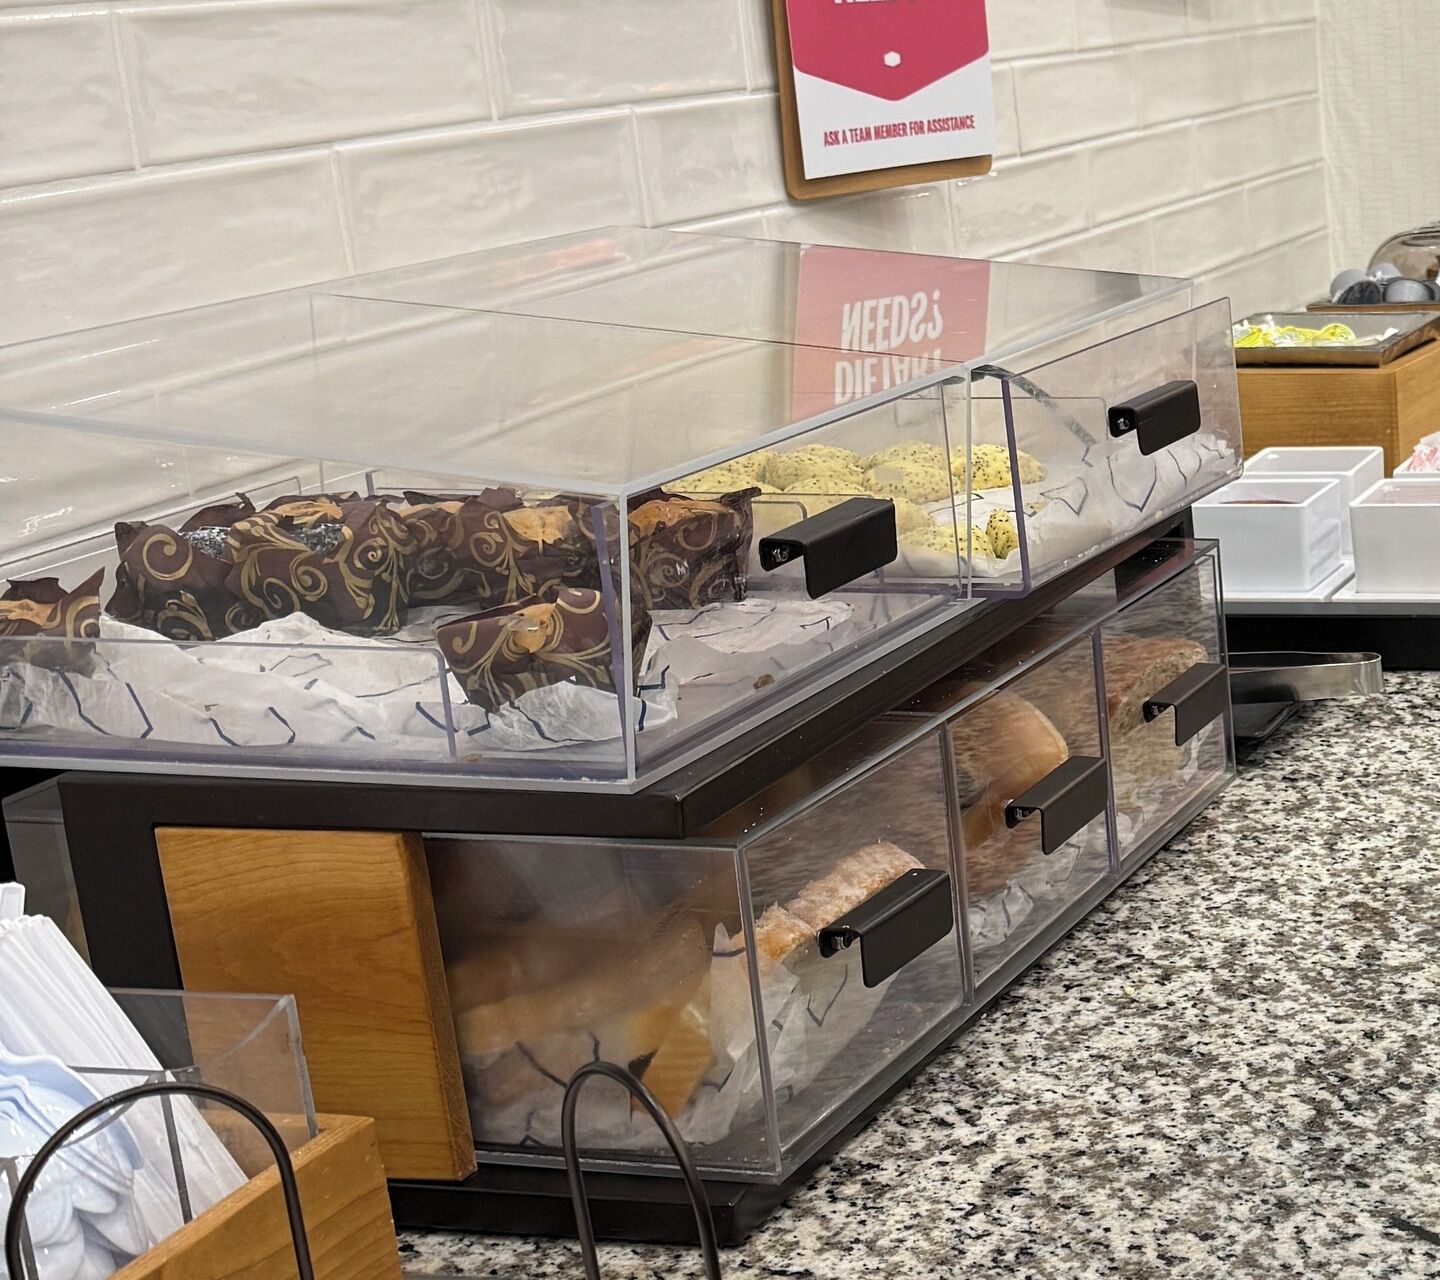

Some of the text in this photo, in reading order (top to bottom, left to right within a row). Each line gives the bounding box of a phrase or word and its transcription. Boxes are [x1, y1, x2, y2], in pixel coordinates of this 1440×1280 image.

[824, 115, 975, 147] ASK A TEAM MEMBER FOR ASSISTANCE
